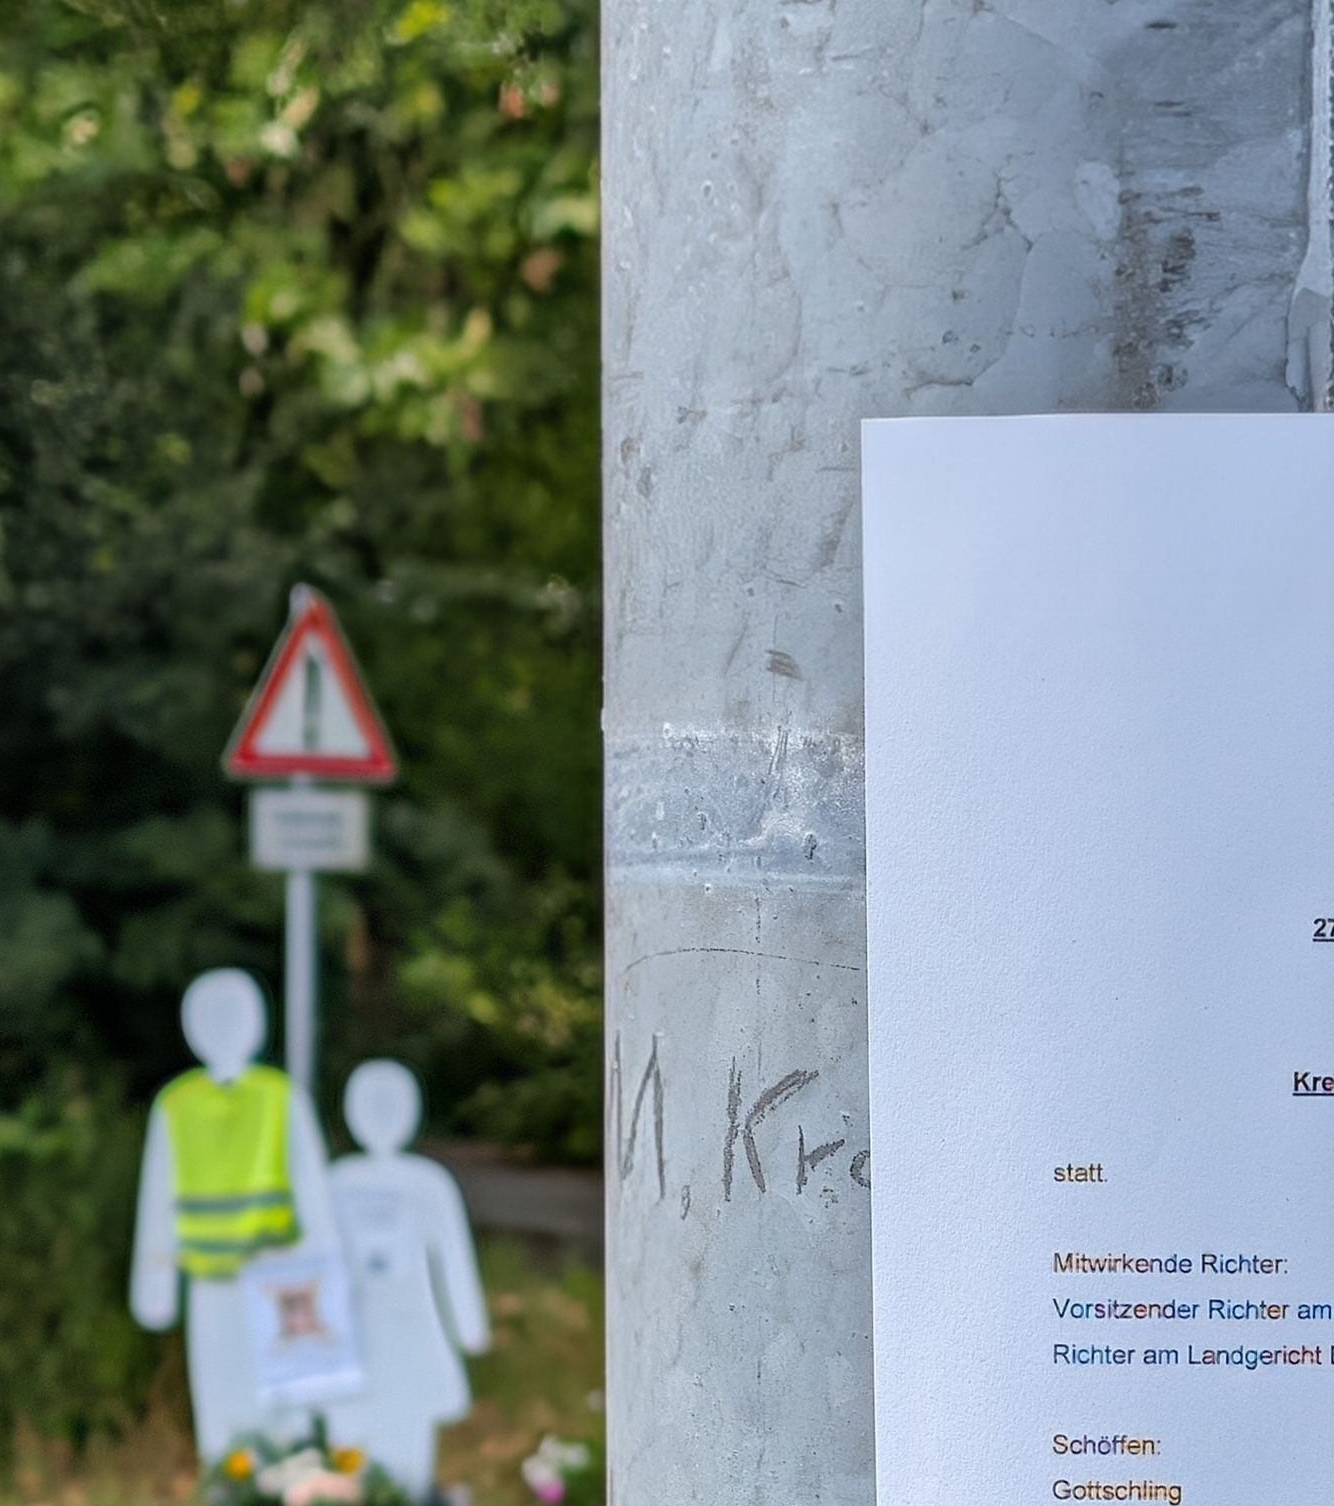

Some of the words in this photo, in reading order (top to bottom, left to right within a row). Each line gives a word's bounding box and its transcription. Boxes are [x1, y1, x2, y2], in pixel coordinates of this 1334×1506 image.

[1054, 1163, 1107, 1182] statt.
[1053, 1253, 1192, 1274] Mitwirkende
[1201, 1253, 1288, 1275] Richter:
[1053, 1298, 1200, 1320] Vorsitzender
[1209, 1299, 1290, 1320] Richter
[1297, 1304, 1331, 1320] am
[1053, 1344, 1135, 1366] Richter
[1143, 1348, 1179, 1366] am
[1188, 1345, 1322, 1370] Landgericht
[1052, 1434, 1161, 1456] Schöffen:
[1052, 1480, 1182, 1506] Gottschling
